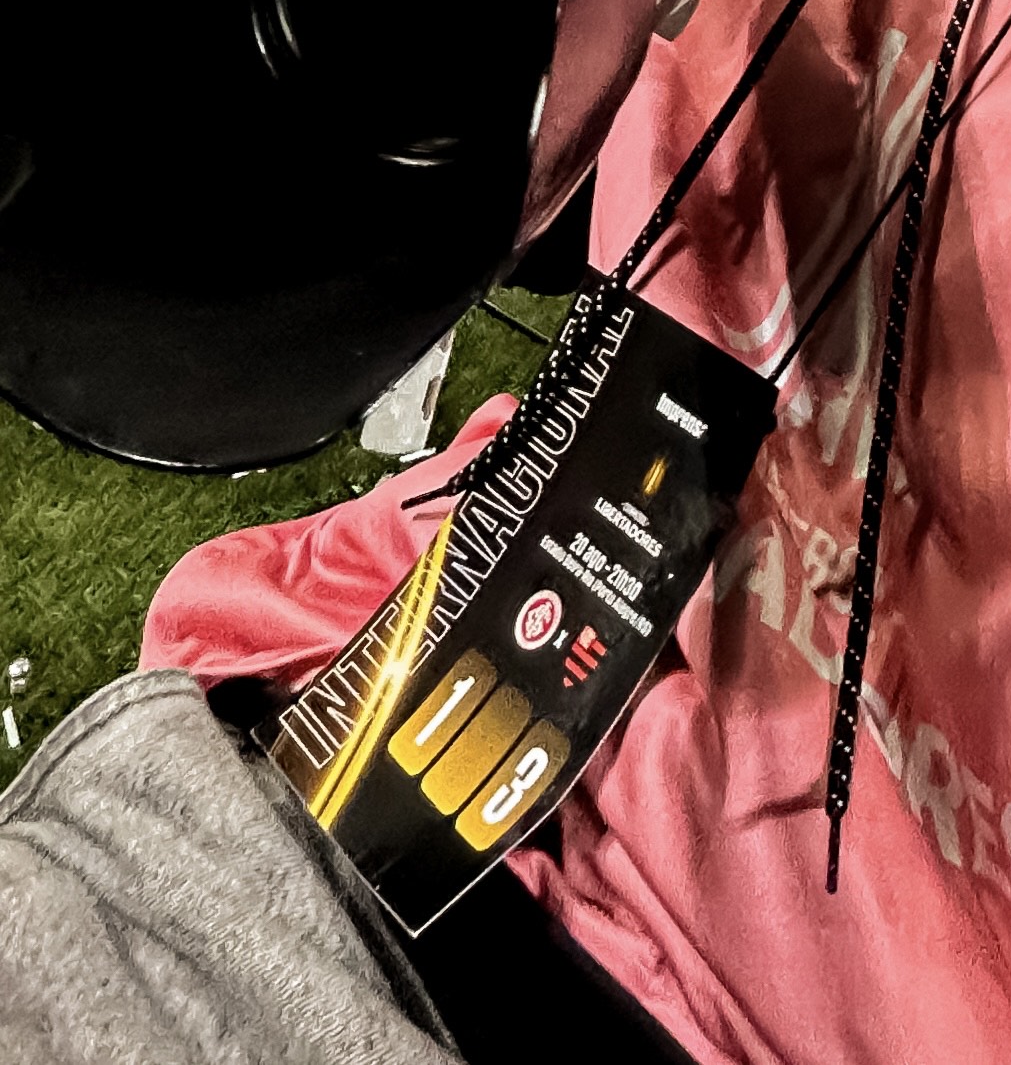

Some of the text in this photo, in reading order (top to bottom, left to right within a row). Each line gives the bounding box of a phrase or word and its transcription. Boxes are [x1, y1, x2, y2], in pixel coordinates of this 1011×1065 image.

[593, 497, 663, 558] LIBERTADORES
[568, 531, 590, 557] 20
[606, 563, 643, 603] 21h30
[415, 674, 550, 826] 1 3
